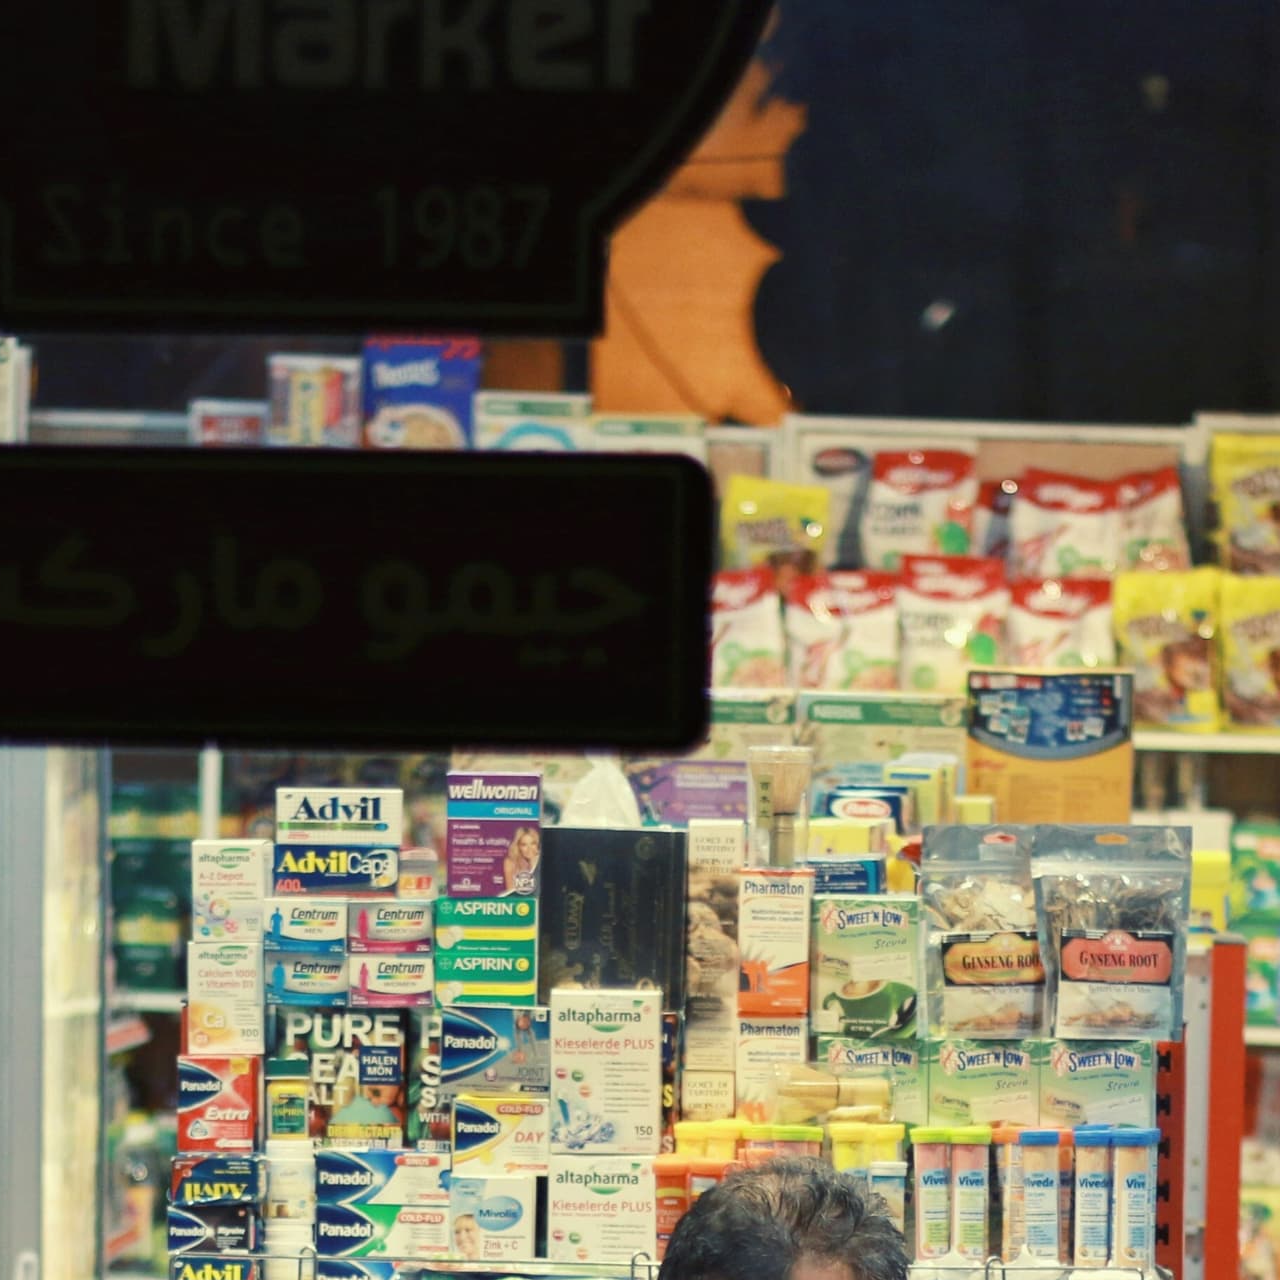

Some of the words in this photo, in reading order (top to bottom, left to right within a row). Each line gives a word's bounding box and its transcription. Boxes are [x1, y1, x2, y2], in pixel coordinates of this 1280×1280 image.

[42, 185, 306, 268] Since
[376, 185, 552, 271] 1987
[449, 779, 538, 800] wellwoman
[290, 796, 382, 821] Advil
[198, 853, 250, 866] altapharma
[744, 880, 804, 895] Pharmaton
[290, 908, 338, 921] Centrum
[377, 908, 424, 921] Centrum
[454, 902, 513, 916] ASPIRIN
[453, 957, 513, 971] ASPIRIN
[962, 954, 1014, 969] GINSENG
[1129, 954, 1159, 967] ROOT
[292, 962, 341, 975] Centrum
[377, 962, 425, 975] Centrum
[558, 1008, 642, 1025] altapharma
[286, 1013, 403, 1047] PURE
[740, 1022, 800, 1037] Pharmaton
[444, 1036, 496, 1049] Panadol
[554, 1039, 620, 1049] Kieselerde
[624, 1039, 655, 1049] PLUS
[362, 1056, 398, 1066] HALEN
[1003, 1050, 1024, 1068] LOW
[1114, 1051, 1135, 1069] LOW
[181, 1080, 220, 1091] Panadol
[204, 1107, 249, 1121] Extra
[457, 1122, 499, 1134] Panadol
[634, 1126, 653, 1136] 150
[515, 1132, 544, 1143] DAY
[320, 1172, 372, 1185] Panadol
[556, 1171, 640, 1186] altapharma
[552, 1201, 618, 1211] Kieselerde
[621, 1201, 652, 1211] PLUS
[479, 1208, 518, 1219] Mivolis
[320, 1224, 372, 1236] Panadol
